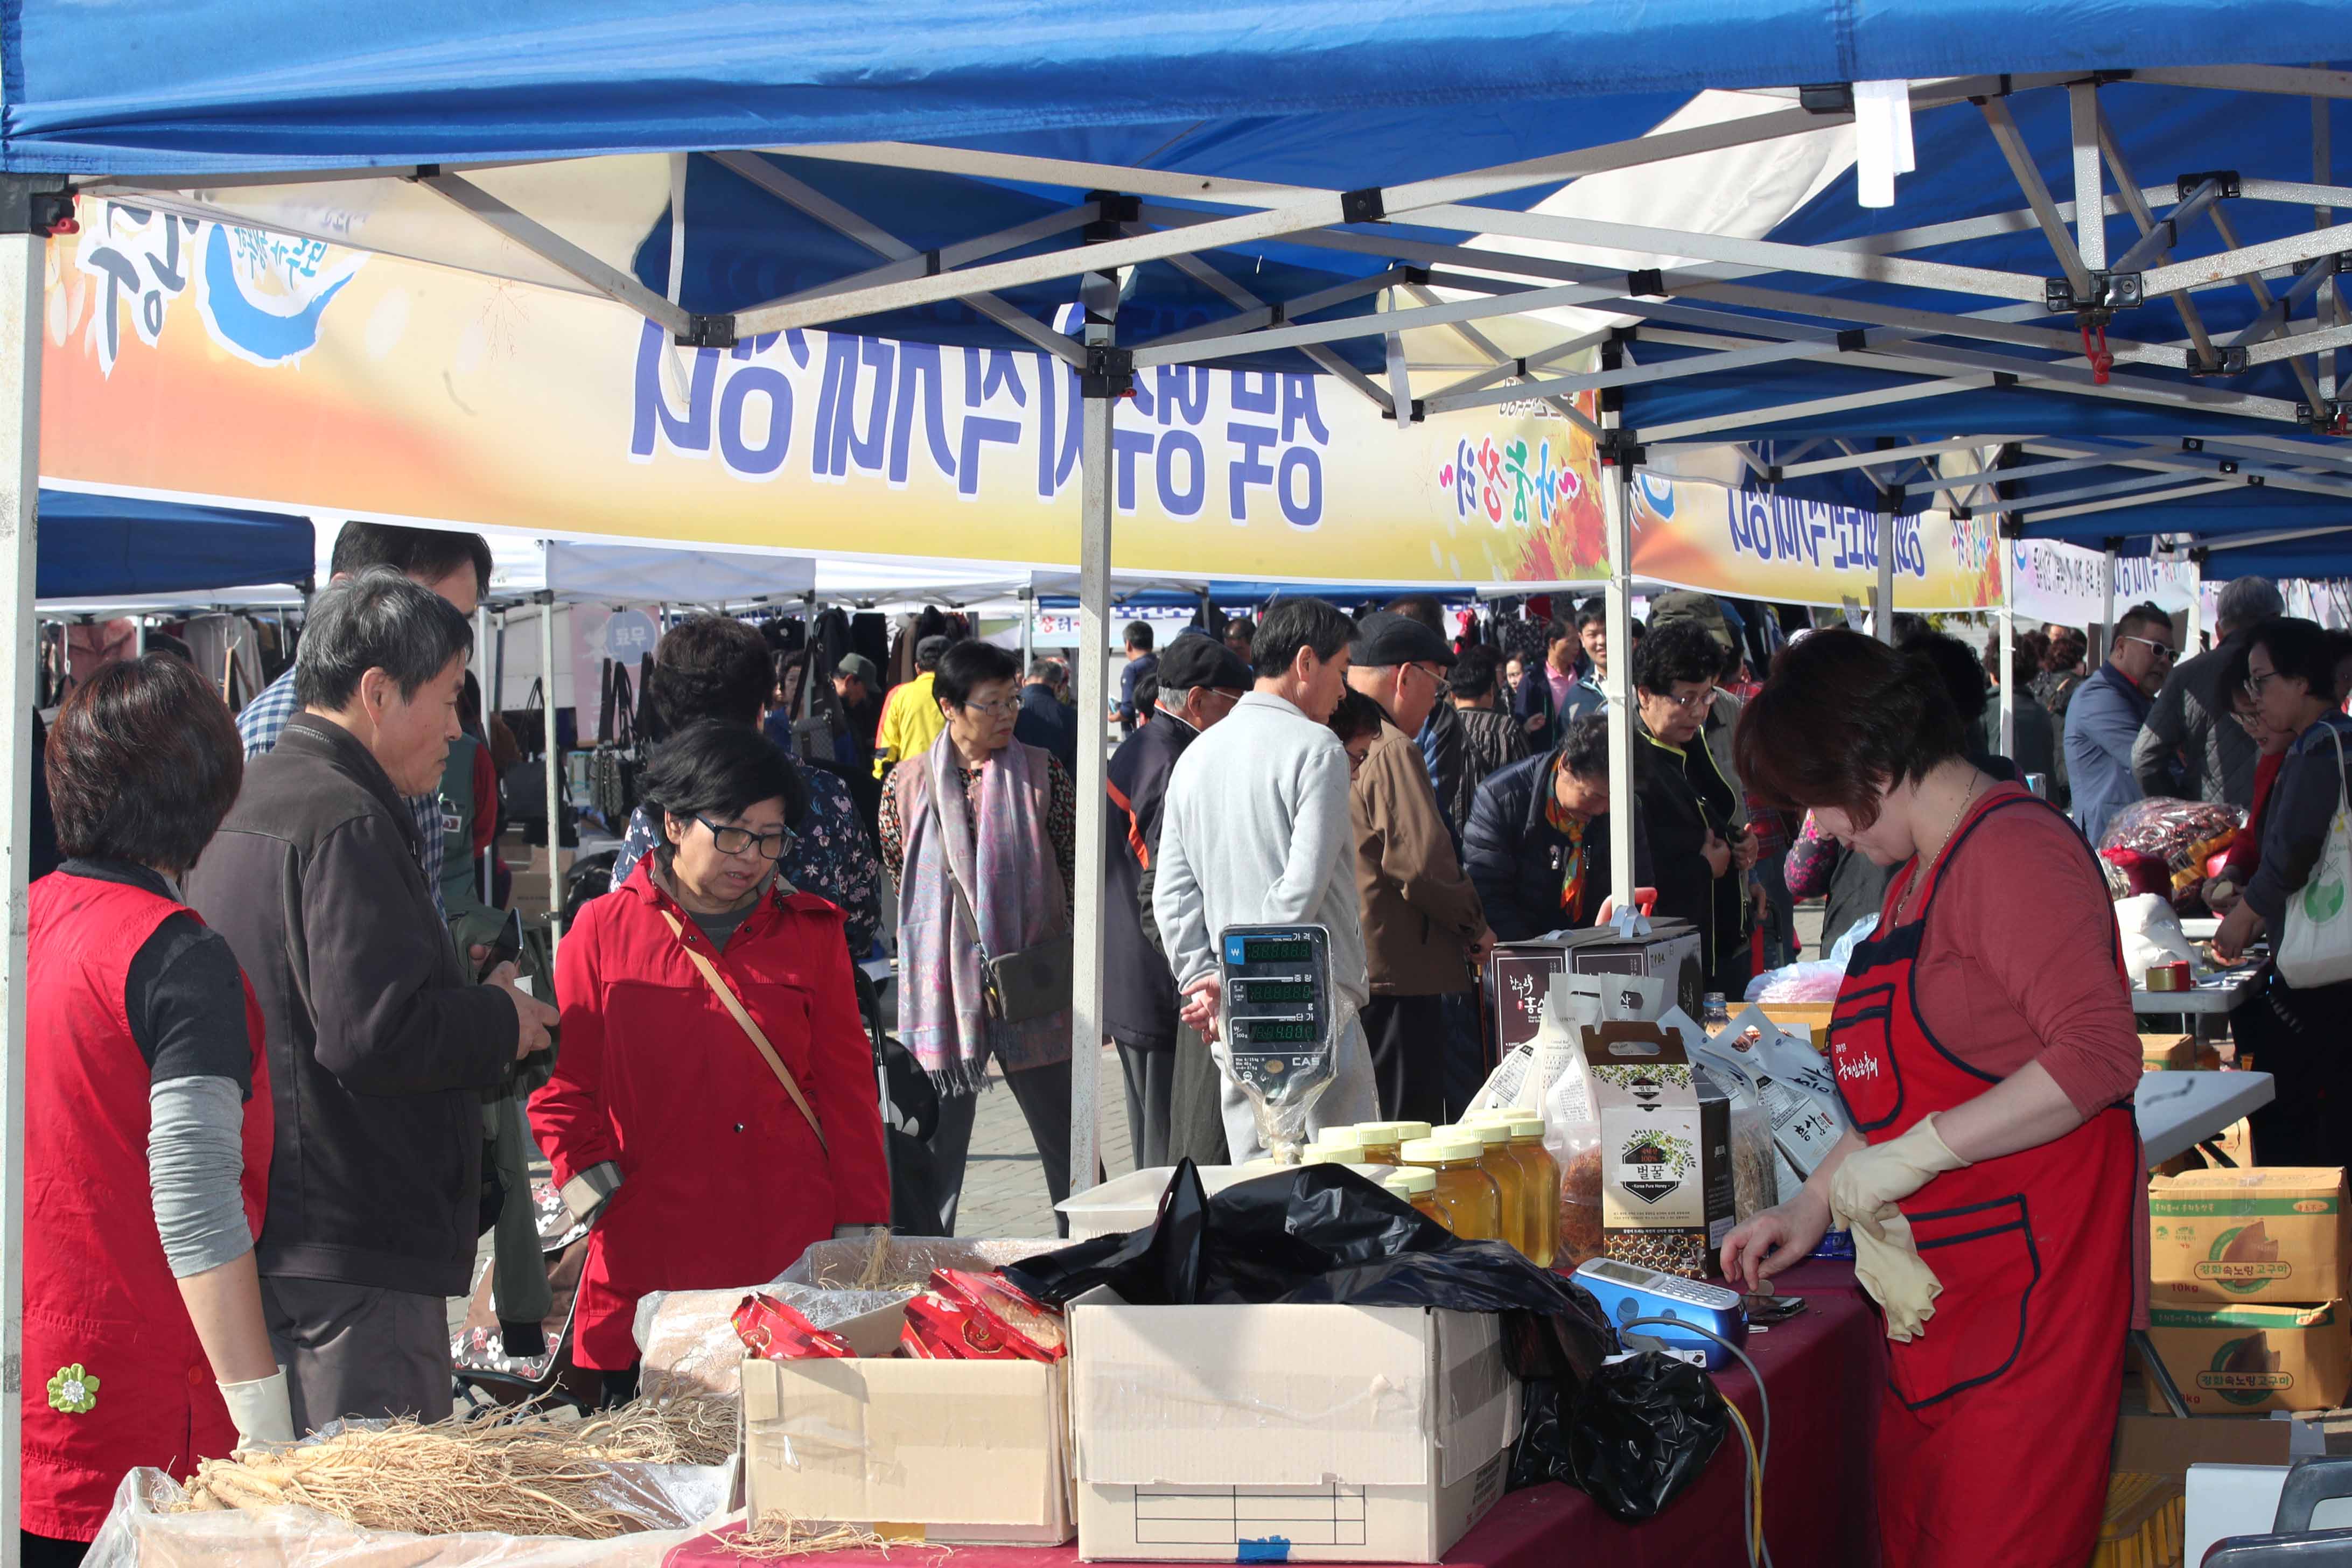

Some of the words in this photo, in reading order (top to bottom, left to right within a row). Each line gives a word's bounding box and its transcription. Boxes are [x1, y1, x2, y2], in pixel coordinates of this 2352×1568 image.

[1292, 1056, 1321, 1067] CAS
[1637, 1164, 1664, 1180] 벌꿀
[2171, 1283, 2199, 1293] 10kg
